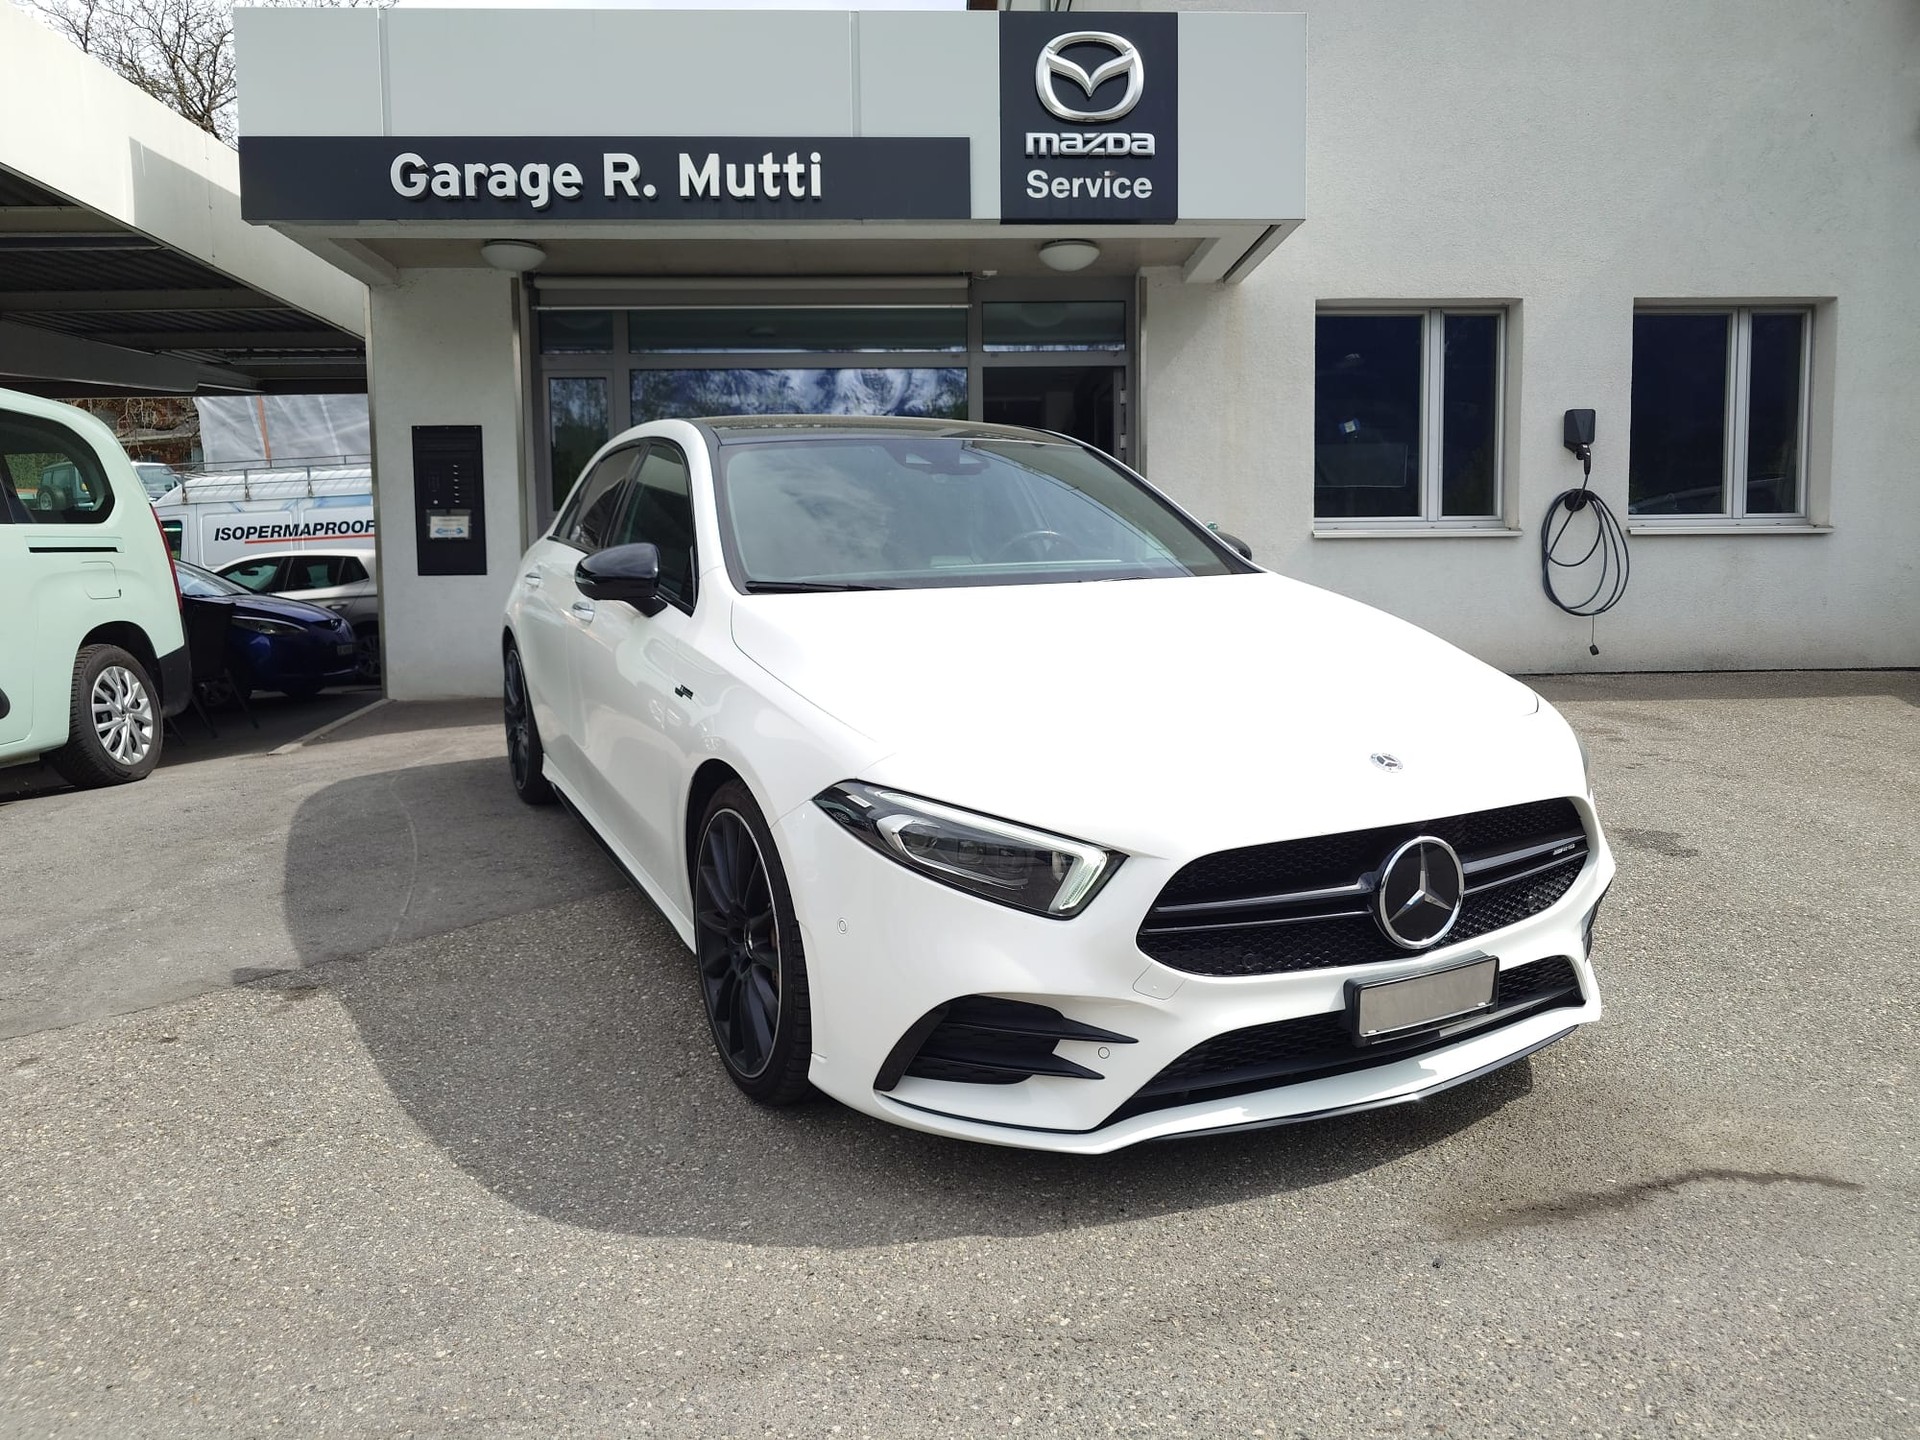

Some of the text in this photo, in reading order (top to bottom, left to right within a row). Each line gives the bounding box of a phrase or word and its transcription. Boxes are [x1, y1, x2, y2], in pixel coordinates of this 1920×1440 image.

[390, 152, 822, 209] Garage R. Mutti
[1026, 169, 1153, 199] Service
[214, 519, 376, 541] ISOPERMAPROOF
